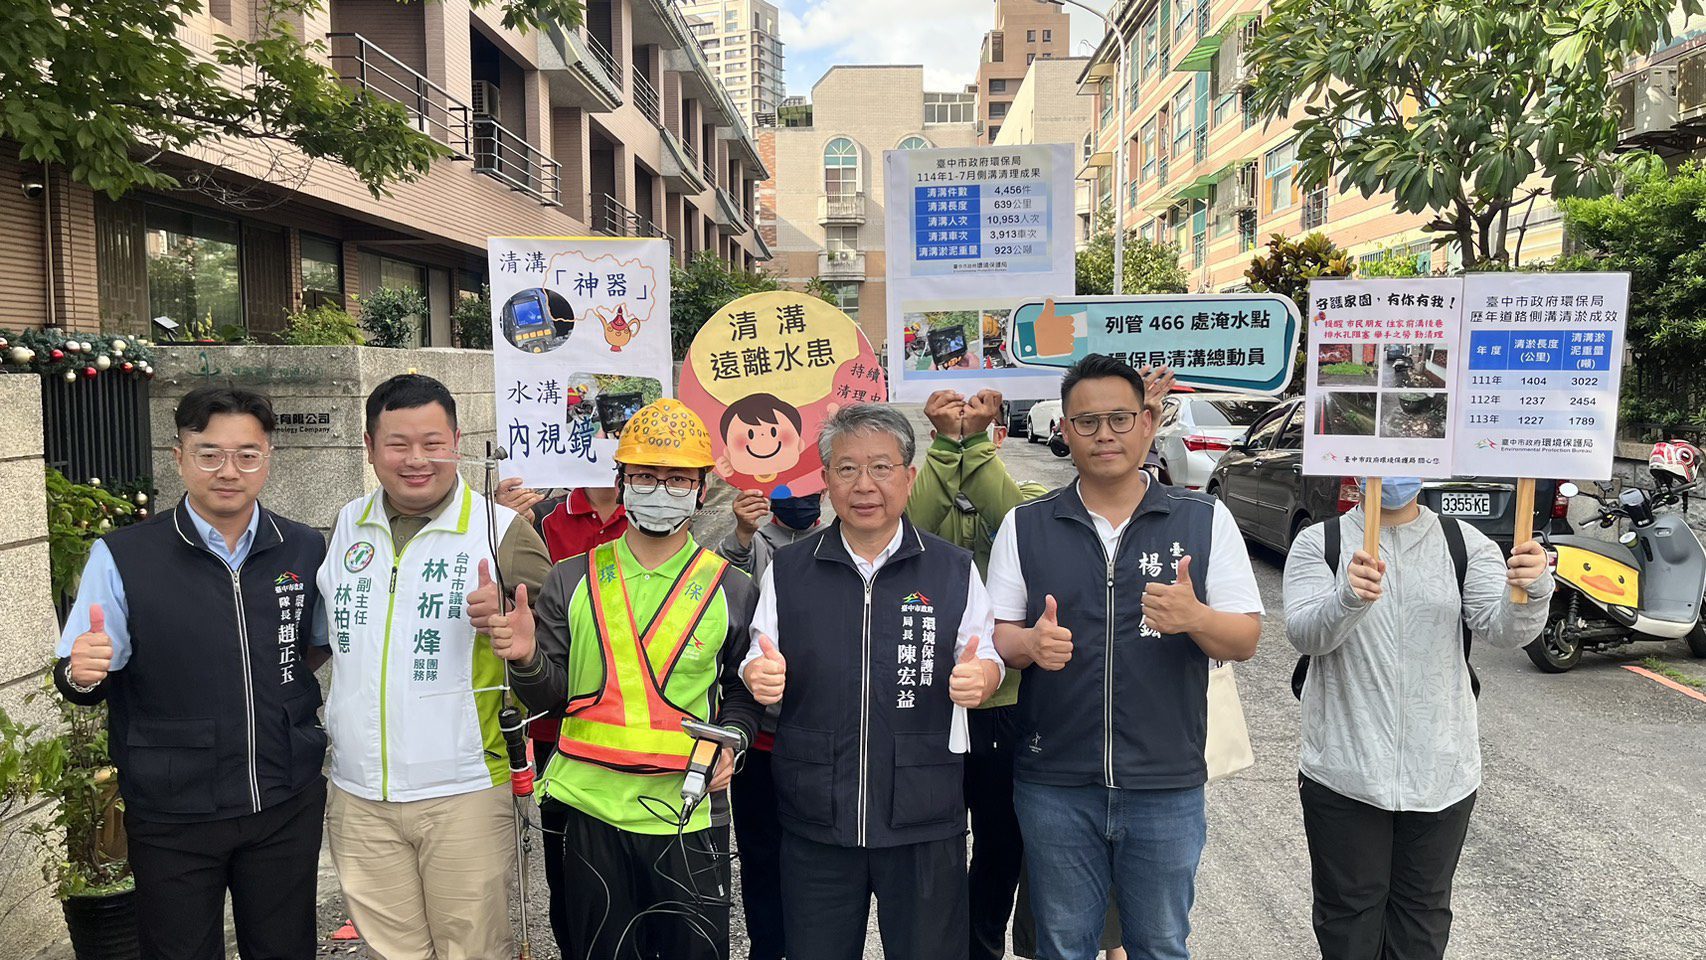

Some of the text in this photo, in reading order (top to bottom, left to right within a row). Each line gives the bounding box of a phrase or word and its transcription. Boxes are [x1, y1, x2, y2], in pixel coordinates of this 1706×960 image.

[936, 156, 1021, 168] 臺中市政府環保局
[917, 168, 1040, 182] 114年1-7月側溝清理成果
[927, 185, 1032, 198] 清溝件數 4,456件
[927, 199, 1032, 212] 清溝長度 639公里
[928, 214, 1040, 227] 清溝人次 10,953人次
[928, 229, 1037, 242] 清溝車次 3,913車次
[499, 250, 547, 274] 清溝
[555, 270, 647, 300] 「神器」
[1486, 295, 1604, 308] 臺中市政府環保局
[728, 303, 806, 342] 清溝
[1105, 310, 1270, 334] 列管 466 處淹水點
[1324, 320, 1343, 328] 提醒
[1347, 319, 1382, 328] 市民朋友
[1470, 311, 1618, 323] 歷年道路側溝清淤成效
[1324, 330, 1371, 339] 排水孔阻塞
[1415, 330, 1444, 339] 勤清理
[1571, 332, 1606, 343] 清溝淤
[1514, 339, 1559, 350] 清淤長度
[1570, 345, 1604, 356] 泥重量
[710, 338, 836, 382] 遠離水患
[1520, 352, 1551, 363] (公里)
[850, 362, 881, 383] 持續
[1472, 376, 1598, 386] 111年 1404 3022
[507, 379, 562, 405] 水溝
[836, 384, 881, 403] 清理中
[1471, 395, 1596, 406] 112年 1237 2454
[1470, 414, 1595, 426] 113年 1227 1789
[300, 426, 330, 434] Company
[509, 416, 597, 464] 內視鏡
[1502, 438, 1593, 447] 臺中市政府環境保護局
[447, 551, 470, 619] 台中市議員
[684, 581, 703, 602] 保
[354, 577, 372, 625] 副主任
[413, 558, 449, 656] 林祈烽
[334, 583, 352, 654] 林柏德
[278, 623, 296, 685] 趙正玉
[919, 616, 936, 687] 環境保護局
[896, 616, 917, 709] 局長 陳宏益
